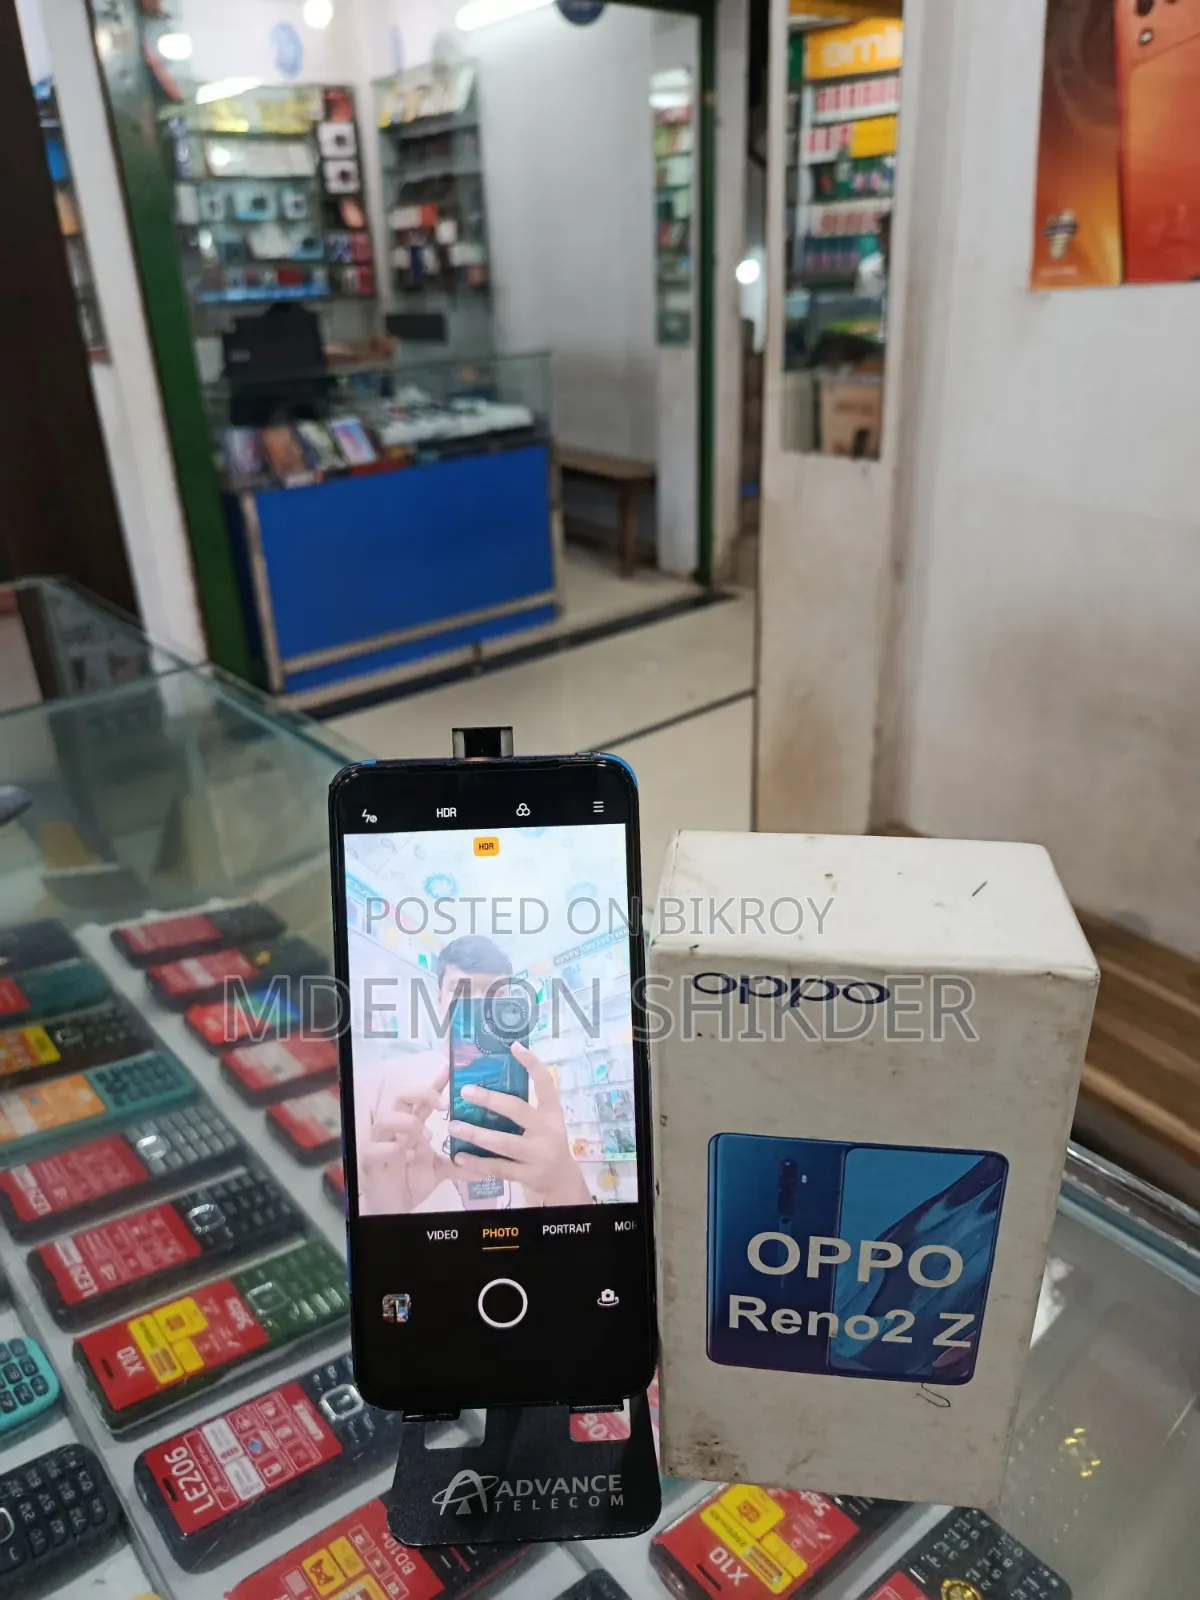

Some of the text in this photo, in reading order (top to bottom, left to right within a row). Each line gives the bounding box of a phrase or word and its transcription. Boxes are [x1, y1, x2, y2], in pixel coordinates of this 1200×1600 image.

[436, 806, 457, 820] HDR
[478, 841, 495, 852] HDR
[691, 970, 892, 1008] oppo
[426, 1229, 459, 1242] VIDEO
[482, 1226, 519, 1239] PHOTO
[542, 1222, 592, 1236] PORTRAIT
[746, 1231, 964, 1288] OPPO
[728, 1294, 976, 1348] Reno2 Z
[117, 1344, 146, 1378] X10
[163, 1445, 215, 1514] LE206
[495, 1474, 623, 1498] ADVANCE
[493, 1494, 625, 1512] TELECOM
[381, 1531, 417, 1575] BD10+
[708, 1546, 750, 1586] X10
